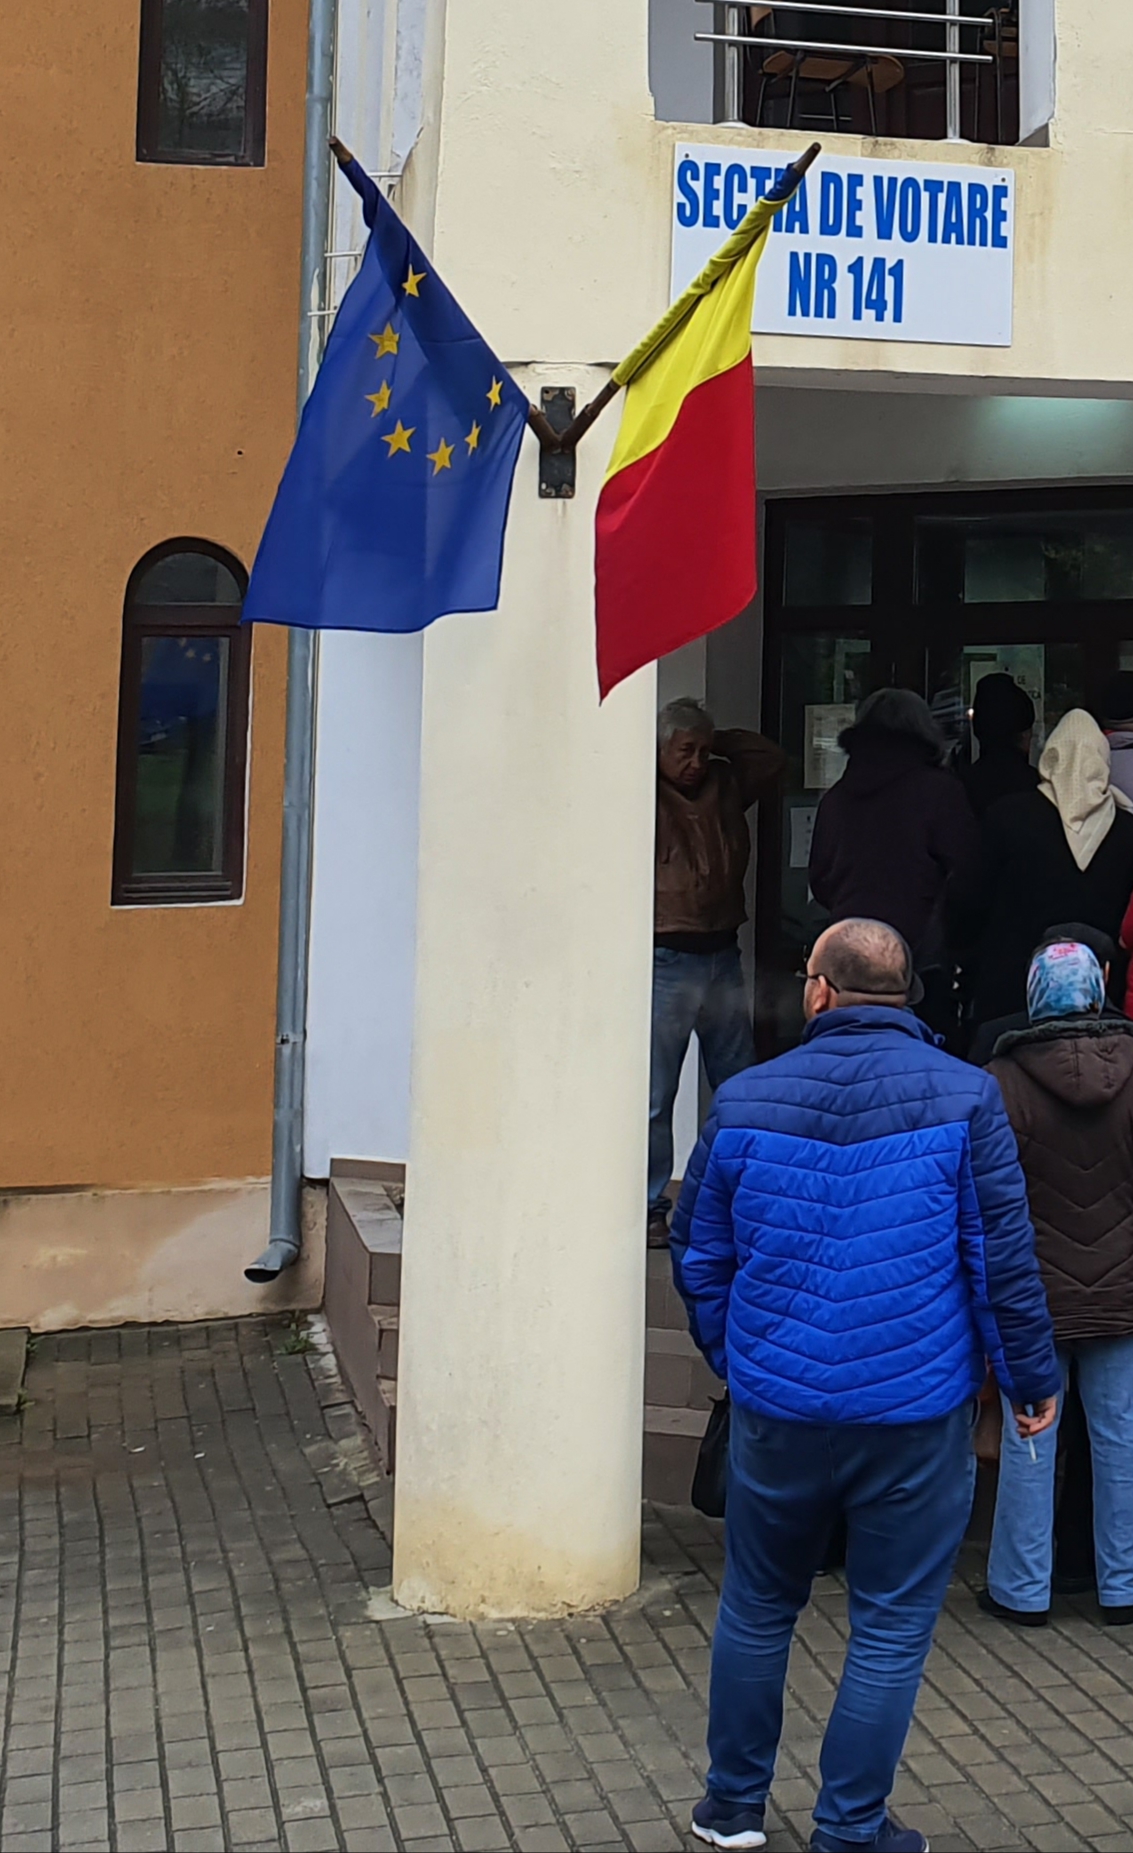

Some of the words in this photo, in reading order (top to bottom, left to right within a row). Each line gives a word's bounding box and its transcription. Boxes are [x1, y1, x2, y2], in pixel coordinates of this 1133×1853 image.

[819, 171, 864, 238] DE
[873, 175, 1008, 249] VOTARE
[787, 251, 838, 319] NR
[847, 256, 904, 323] 141
